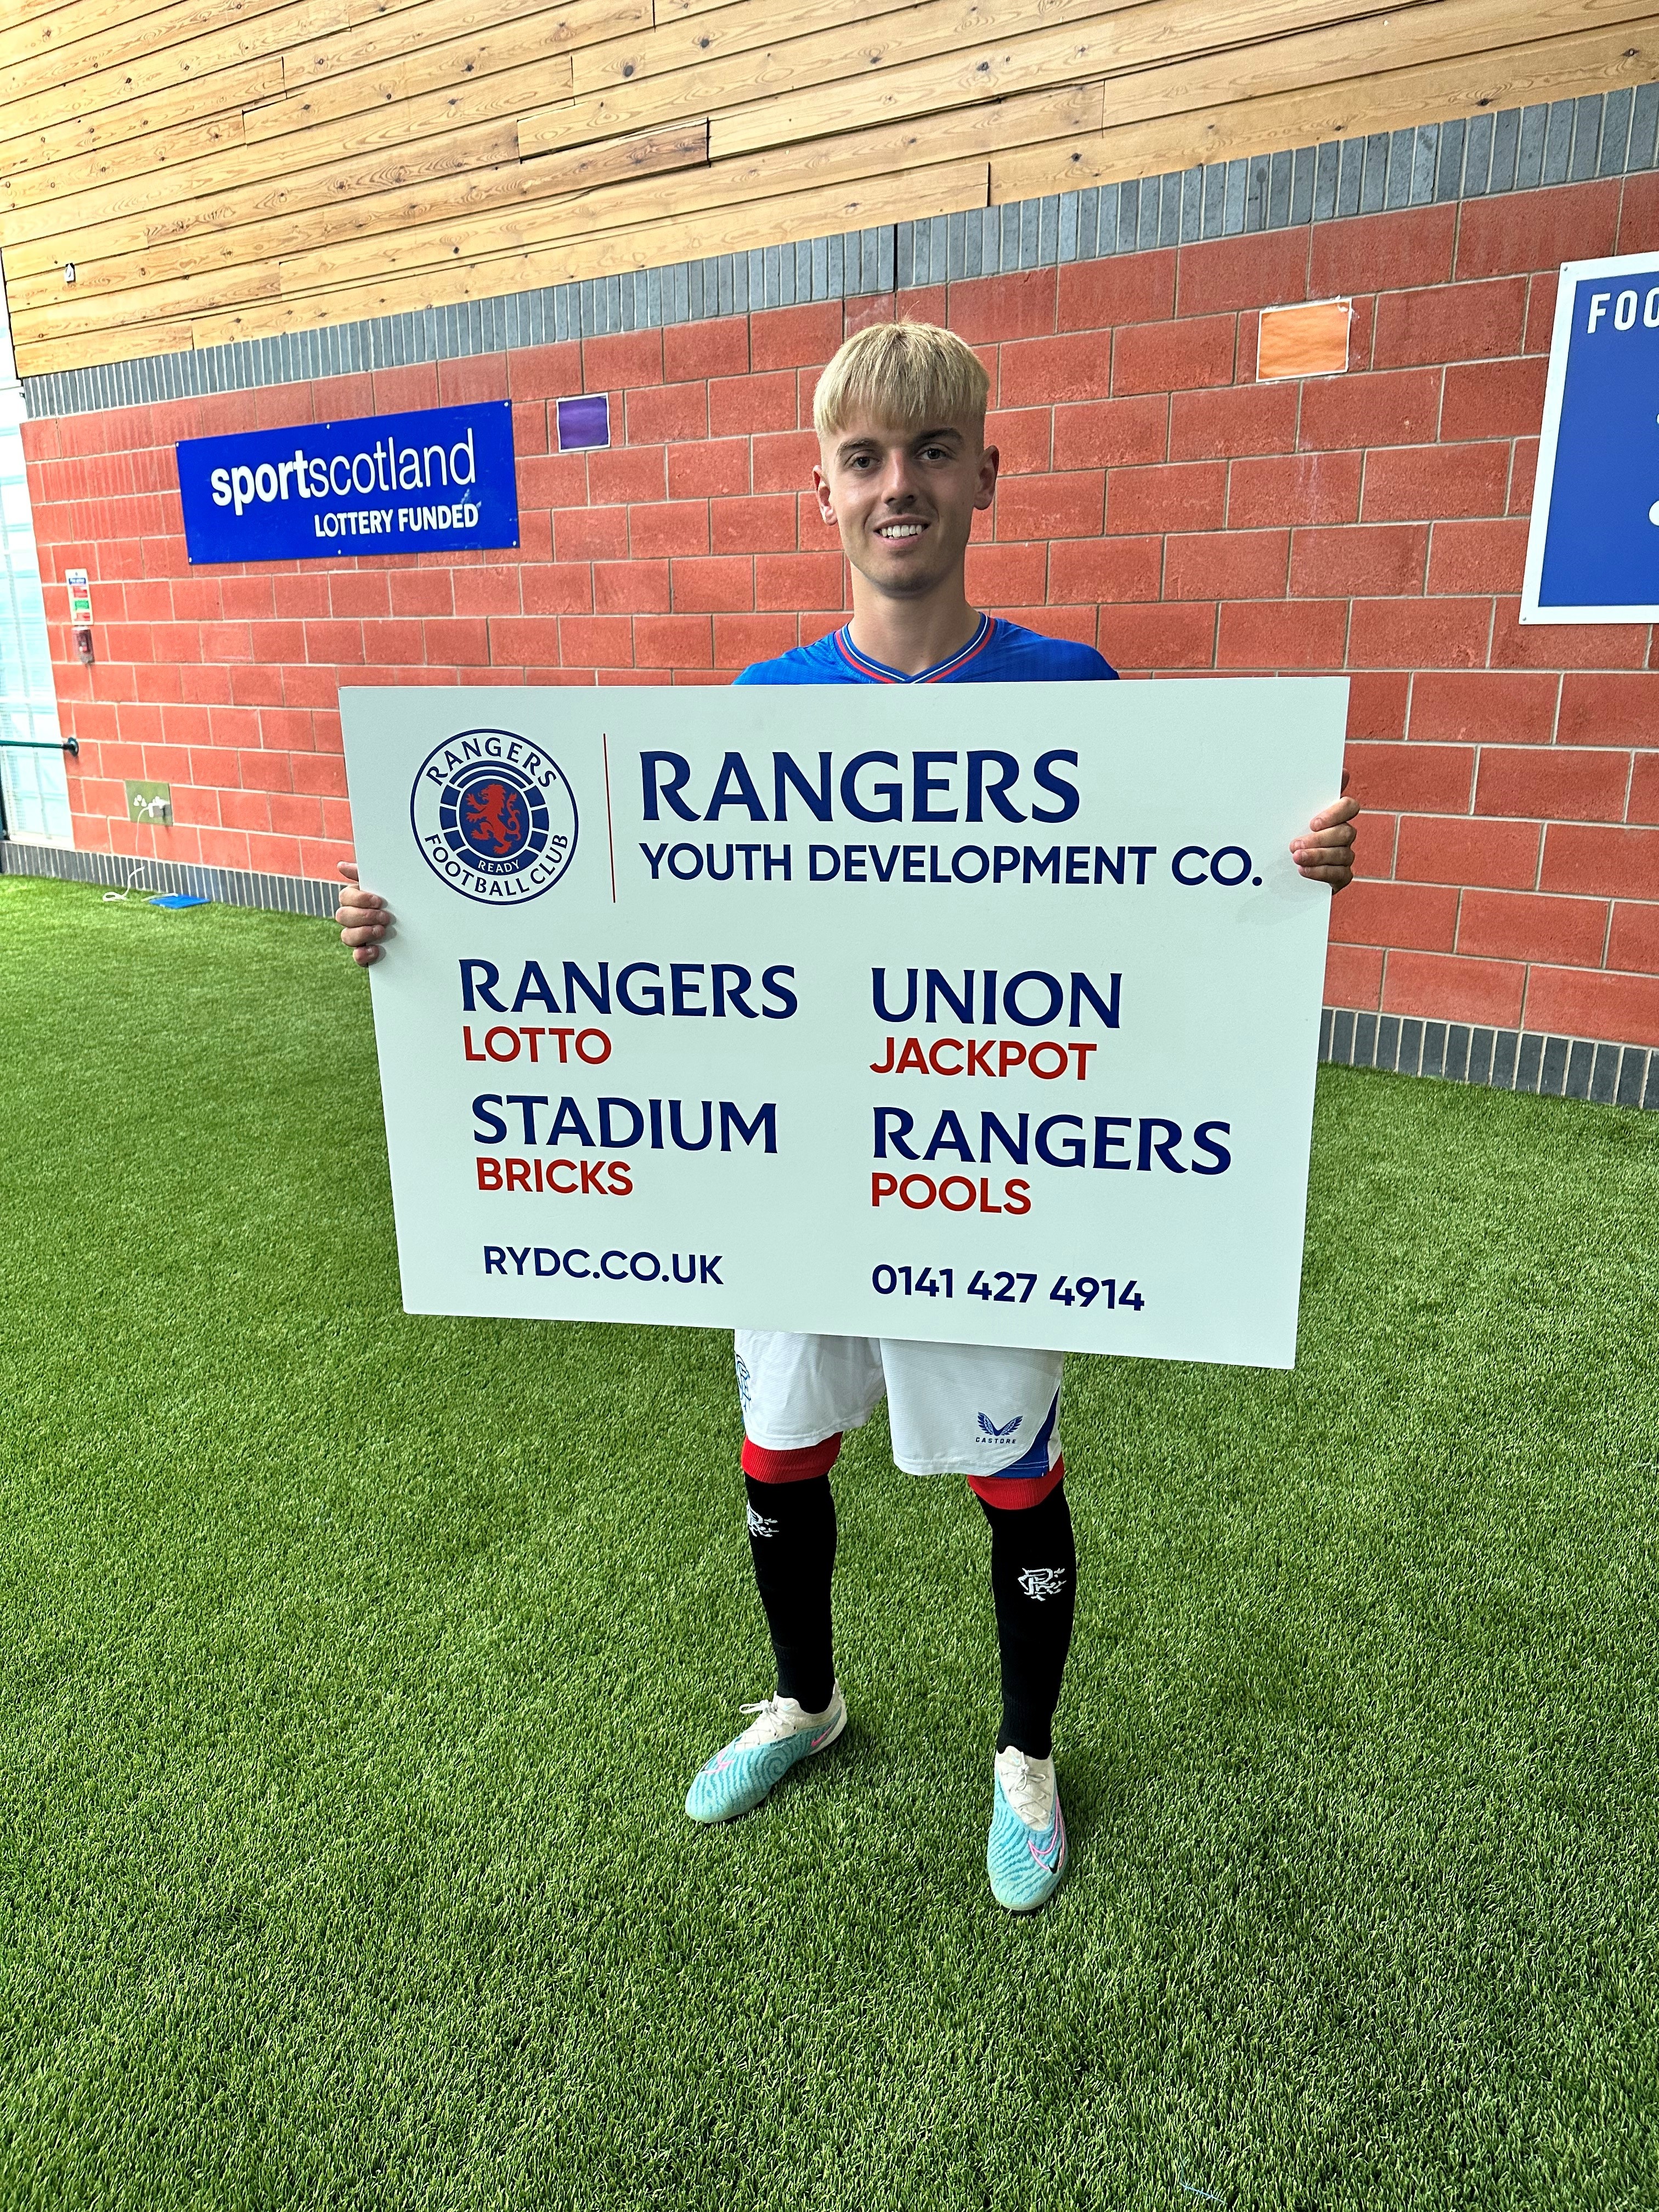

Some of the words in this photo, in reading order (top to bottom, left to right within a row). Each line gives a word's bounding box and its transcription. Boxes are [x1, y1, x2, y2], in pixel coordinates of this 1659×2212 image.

[211, 428, 476, 515] sportscotland
[314, 509, 393, 537] LOTTERY
[398, 503, 479, 532] FUNDED
[426, 737, 556, 787] RANGERS
[640, 749, 1079, 823] RANGERS
[425, 834, 530, 896] FOOTBALL
[531, 835, 568, 884] CLUB
[478, 859, 519, 873] READY
[639, 843, 791, 881] YOUTH
[809, 845, 1156, 884] DEVELOPMENT
[1172, 846, 1262, 886] CO.
[459, 959, 797, 1019] RANGERS
[872, 968, 1122, 1028] UNION
[463, 1026, 611, 1064] LOTTO
[870, 1037, 1097, 1080] JACKPOT
[472, 1094, 777, 1153] STADIUM
[873, 1107, 1231, 1175] RANGERS
[477, 1158, 633, 1195] BRICKS
[872, 1172, 1031, 1215] POOLS
[484, 1246, 724, 1284] RYDC.CO.UK
[872, 1265, 952, 1298] 0141
[967, 1271, 1037, 1303] 427
[1050, 1276, 1144, 1311] 4914
